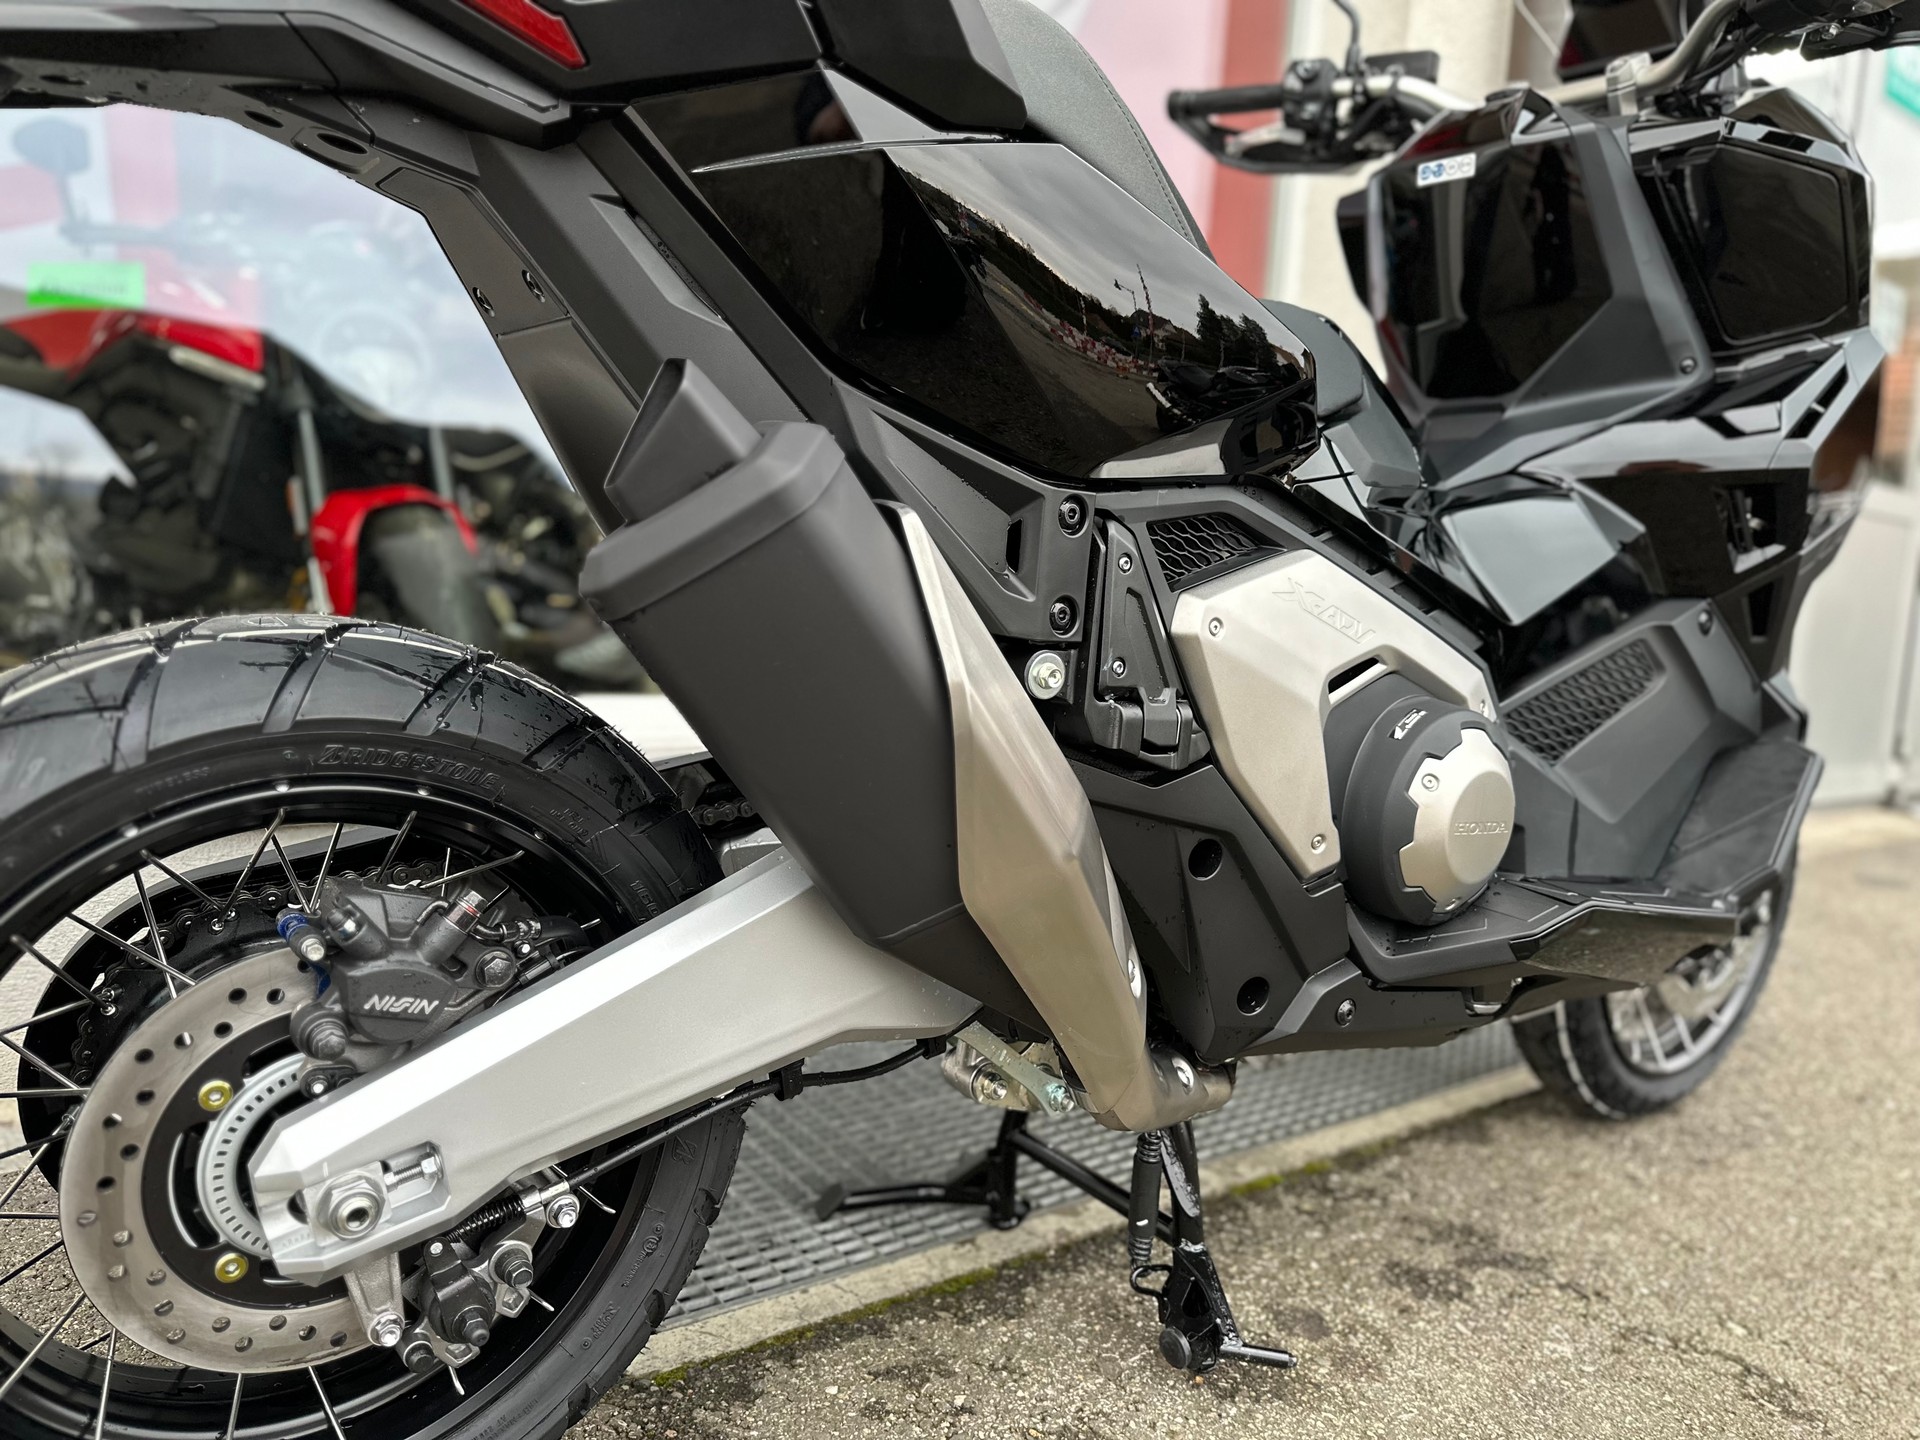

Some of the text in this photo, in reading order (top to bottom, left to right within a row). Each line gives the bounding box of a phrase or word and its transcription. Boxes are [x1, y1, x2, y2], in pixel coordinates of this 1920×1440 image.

[1272, 577, 1376, 644] X-ADV
[318, 744, 500, 789] BRIDGESTONE
[1453, 822, 1508, 836] HONDA
[363, 994, 440, 1015] NISSIN
